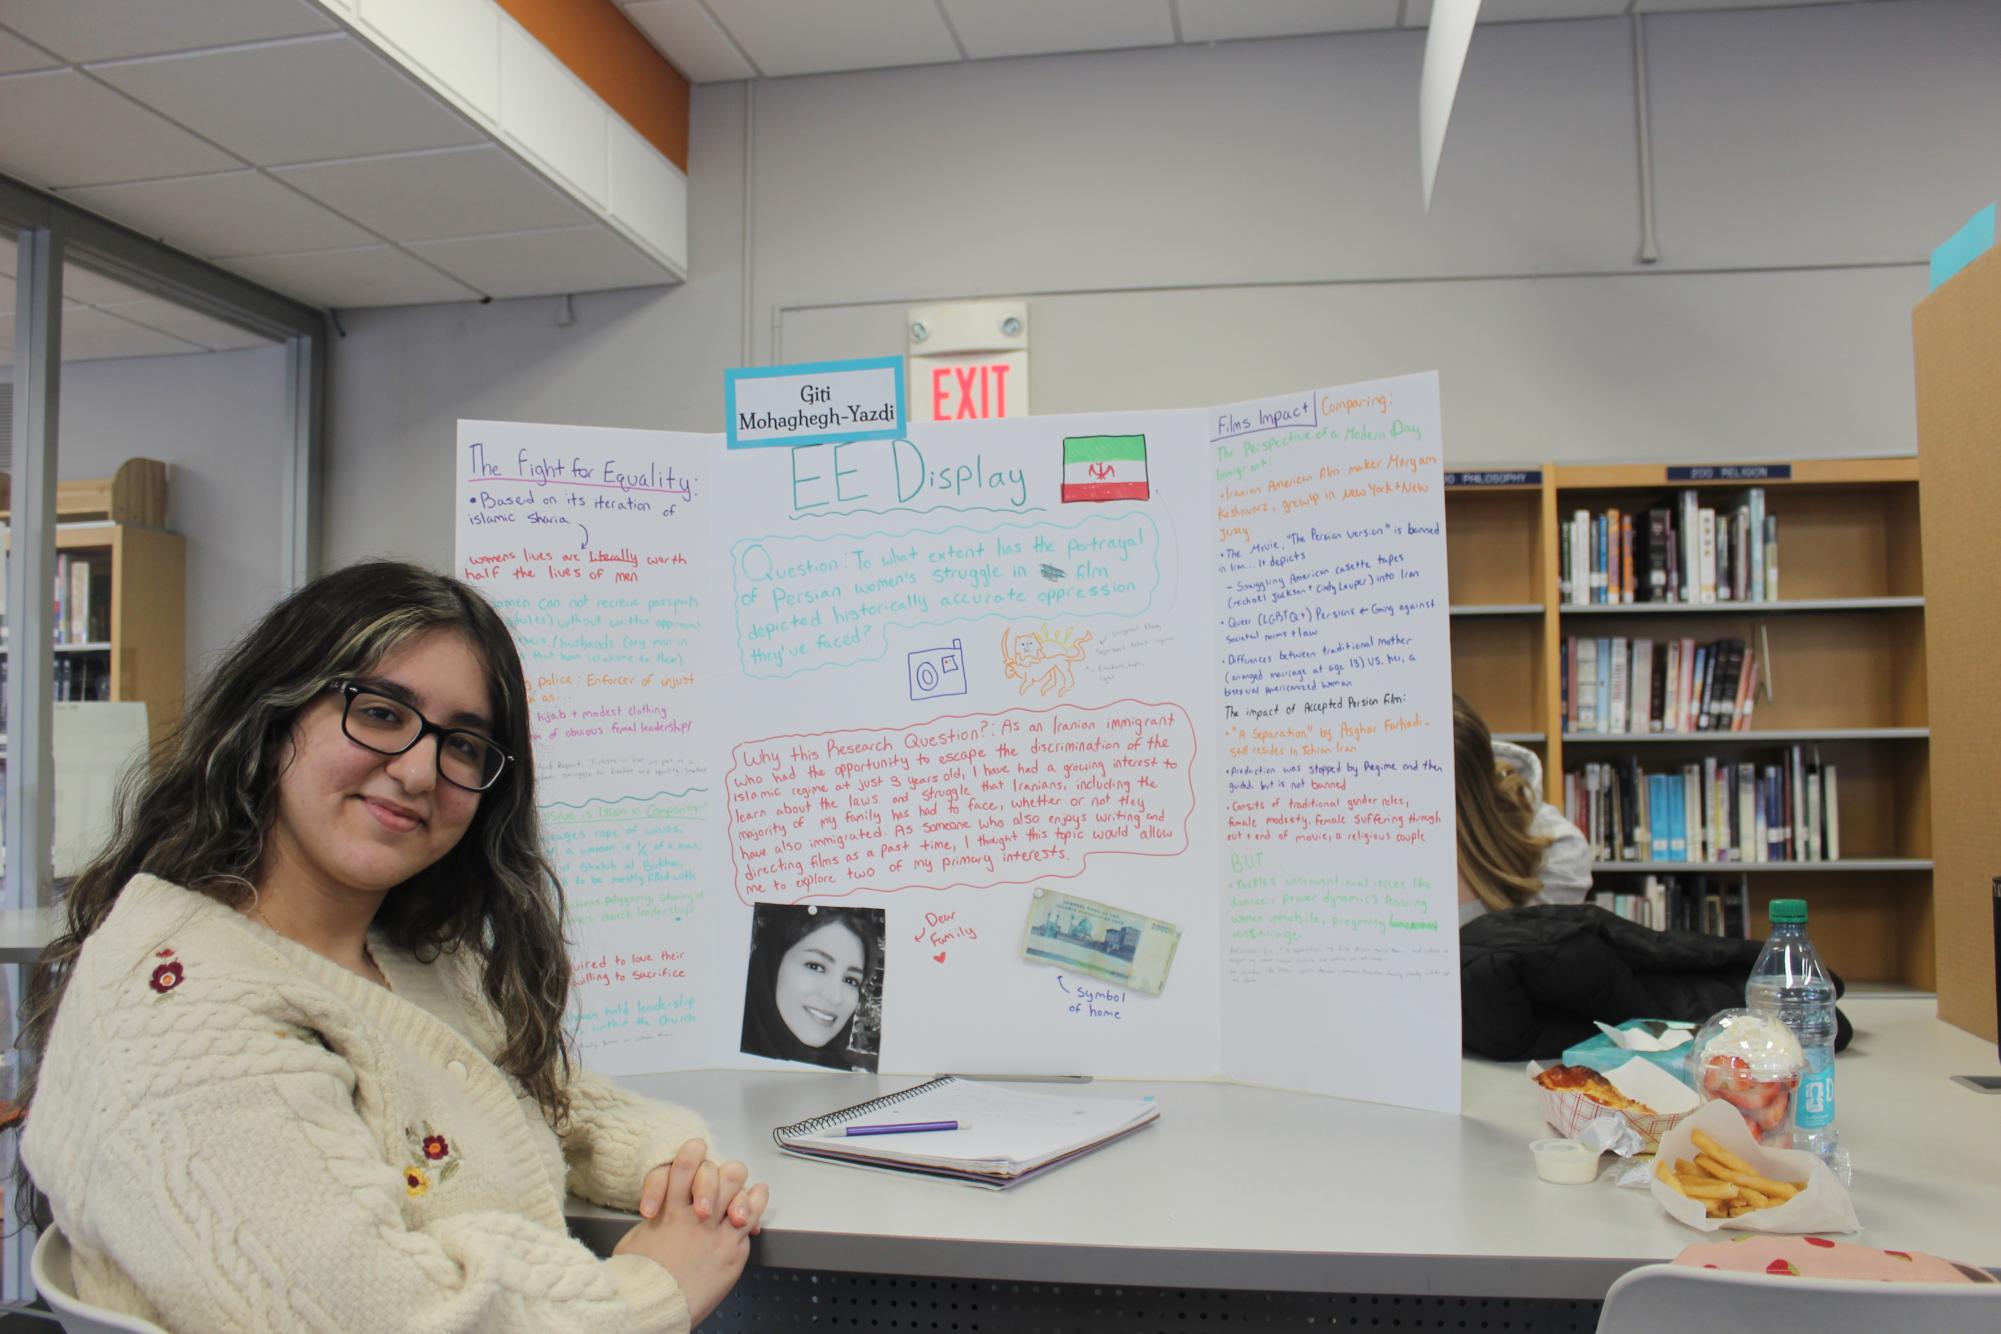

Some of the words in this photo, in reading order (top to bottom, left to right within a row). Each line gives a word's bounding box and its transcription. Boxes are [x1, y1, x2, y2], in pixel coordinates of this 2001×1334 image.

[800, 385, 831, 404] Giti
[932, 364, 1010, 421] EXIT
[738, 404, 895, 433] Mohaghegh-Yazdi
[1259, 401, 1309, 428] Impact
[469, 443, 502, 476] The
[572, 457, 595, 479] for
[603, 460, 699, 502] Equality:
[791, 440, 869, 511] EE
[893, 439, 1027, 506] Display
[1462, 472, 1527, 485] PHILOSOPHY
[1720, 467, 1768, 478] RELIGION
[480, 490, 535, 510] Based
[542, 495, 558, 506] on
[567, 492, 586, 507] its
[594, 494, 651, 512] iteration
[662, 504, 677, 517] of
[469, 512, 516, 526] islamic
[1226, 548, 1241, 559] The
[1394, 525, 1402, 535] is
[1407, 521, 1440, 536] banned
[523, 548, 553, 562] lives
[562, 553, 580, 563] are
[646, 553, 688, 566] worth
[742, 543, 847, 582] Question:
[852, 549, 872, 571] To
[882, 547, 918, 566] what
[928, 543, 984, 563] extent
[997, 536, 1022, 557] has
[1033, 534, 1055, 553] the
[1067, 527, 1144, 562] portrayal
[465, 566, 501, 580] half
[512, 566, 535, 578] the
[549, 565, 582, 580] lives
[589, 567, 604, 580] of
[615, 571, 638, 583] men
[741, 587, 758, 605] of
[772, 587, 842, 613] Persian
[855, 572, 917, 595] women's
[932, 563, 1002, 588] struggle
[1013, 565, 1027, 578] in
[1076, 559, 1109, 580] film
[748, 610, 821, 641] depicted
[833, 594, 929, 625] historically
[940, 588, 1026, 607] accurate
[1038, 581, 1136, 607] oppression
[750, 643, 808, 667] they've
[816, 624, 871, 648] faced?
[586, 674, 636, 688] Enforcer
[641, 674, 654, 687] of
[660, 674, 695, 690] unjust
[537, 708, 566, 723] hijab
[583, 705, 620, 718] modest
[1225, 706, 1240, 719] The
[1246, 704, 1279, 721] impact
[1286, 704, 1297, 715] of
[1304, 696, 1343, 714] Accepted
[743, 748, 780, 771] Why
[791, 744, 820, 763] this
[827, 736, 893, 758] Research
[1001, 719, 1020, 735] As
[1029, 723, 1042, 732] an
[1052, 715, 1095, 735] Iranian
[1106, 713, 1176, 735] immigrant
[735, 774, 763, 787] who
[772, 766, 796, 783] had
[807, 765, 825, 779] the
[916, 753, 930, 766] to
[938, 748, 986, 765] escape
[996, 744, 1018, 758] the
[1030, 737, 1120, 753] discrimination
[1127, 737, 1142, 751] of
[1146, 734, 1170, 749] the
[792, 784, 828, 798] regime
[835, 781, 850, 792] at
[858, 777, 882, 792] just
[890, 776, 901, 787] 3
[908, 775, 938, 790] years
[983, 762, 1010, 776] have
[1017, 760, 1038, 774] had
[1047, 763, 1055, 773] a
[1063, 759, 1106, 778] growing
[1113, 755, 1157, 768] interest
[1163, 758, 1177, 770] to
[740, 844, 767, 860] have
[775, 840, 802, 854] also
[895, 824, 913, 837] As
[979, 816, 1004, 828] who
[1013, 813, 1040, 825] also
[1049, 814, 1087, 829] enjoys
[1095, 809, 1141, 828] writing
[1146, 809, 1165, 821] and
[1228, 816, 1259, 828] female
[745, 859, 803, 881] directing
[810, 853, 839, 867] films
[845, 852, 859, 862] as
[867, 850, 875, 858] a
[880, 842, 910, 859] past
[919, 838, 956, 853] time,
[1026, 826, 1048, 841] this
[1054, 827, 1085, 844] topic
[1093, 826, 1128, 839] would
[1140, 825, 1173, 840] allow
[746, 884, 766, 894] me
[773, 881, 786, 891] to
[796, 874, 837, 892] explore
[848, 867, 876, 879] two
[889, 859, 904, 872] of
[913, 860, 933, 872] my
[942, 853, 994, 873] primary
[925, 911, 956, 927] Dear
[615, 955, 626, 966] to
[632, 952, 653, 964] love
[661, 951, 685, 961] their
[615, 971, 626, 982] to
[632, 967, 686, 980] sacrifice
[1068, 1004, 1081, 1013] of
[1089, 1004, 1121, 1020] home
